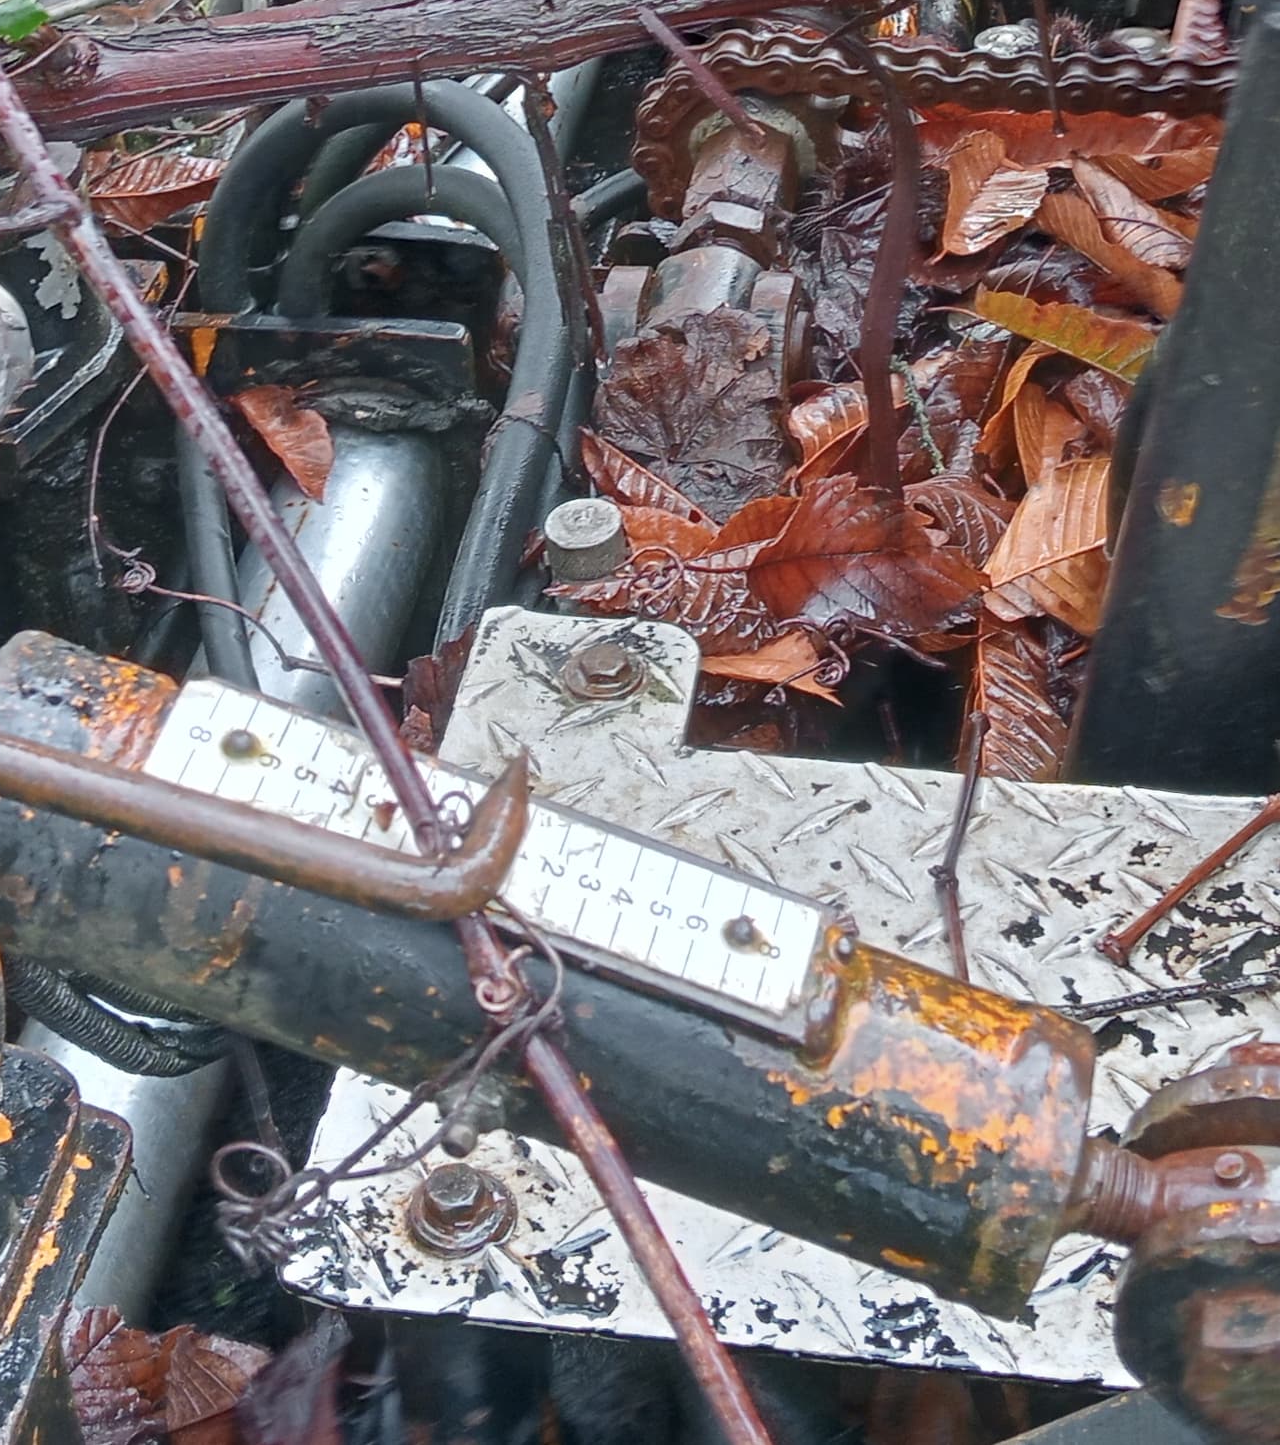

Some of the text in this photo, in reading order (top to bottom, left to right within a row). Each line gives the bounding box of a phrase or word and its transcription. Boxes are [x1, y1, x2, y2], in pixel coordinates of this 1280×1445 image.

[189, 726, 212, 742] 8
[258, 751, 282, 770] 6
[294, 765, 318, 784] 5
[329, 778, 353, 797] 4
[541, 855, 565, 877] 2
[578, 874, 601, 892] 3
[611, 887, 634, 906] 4
[649, 900, 672, 920] 5
[685, 915, 709, 933] 6
